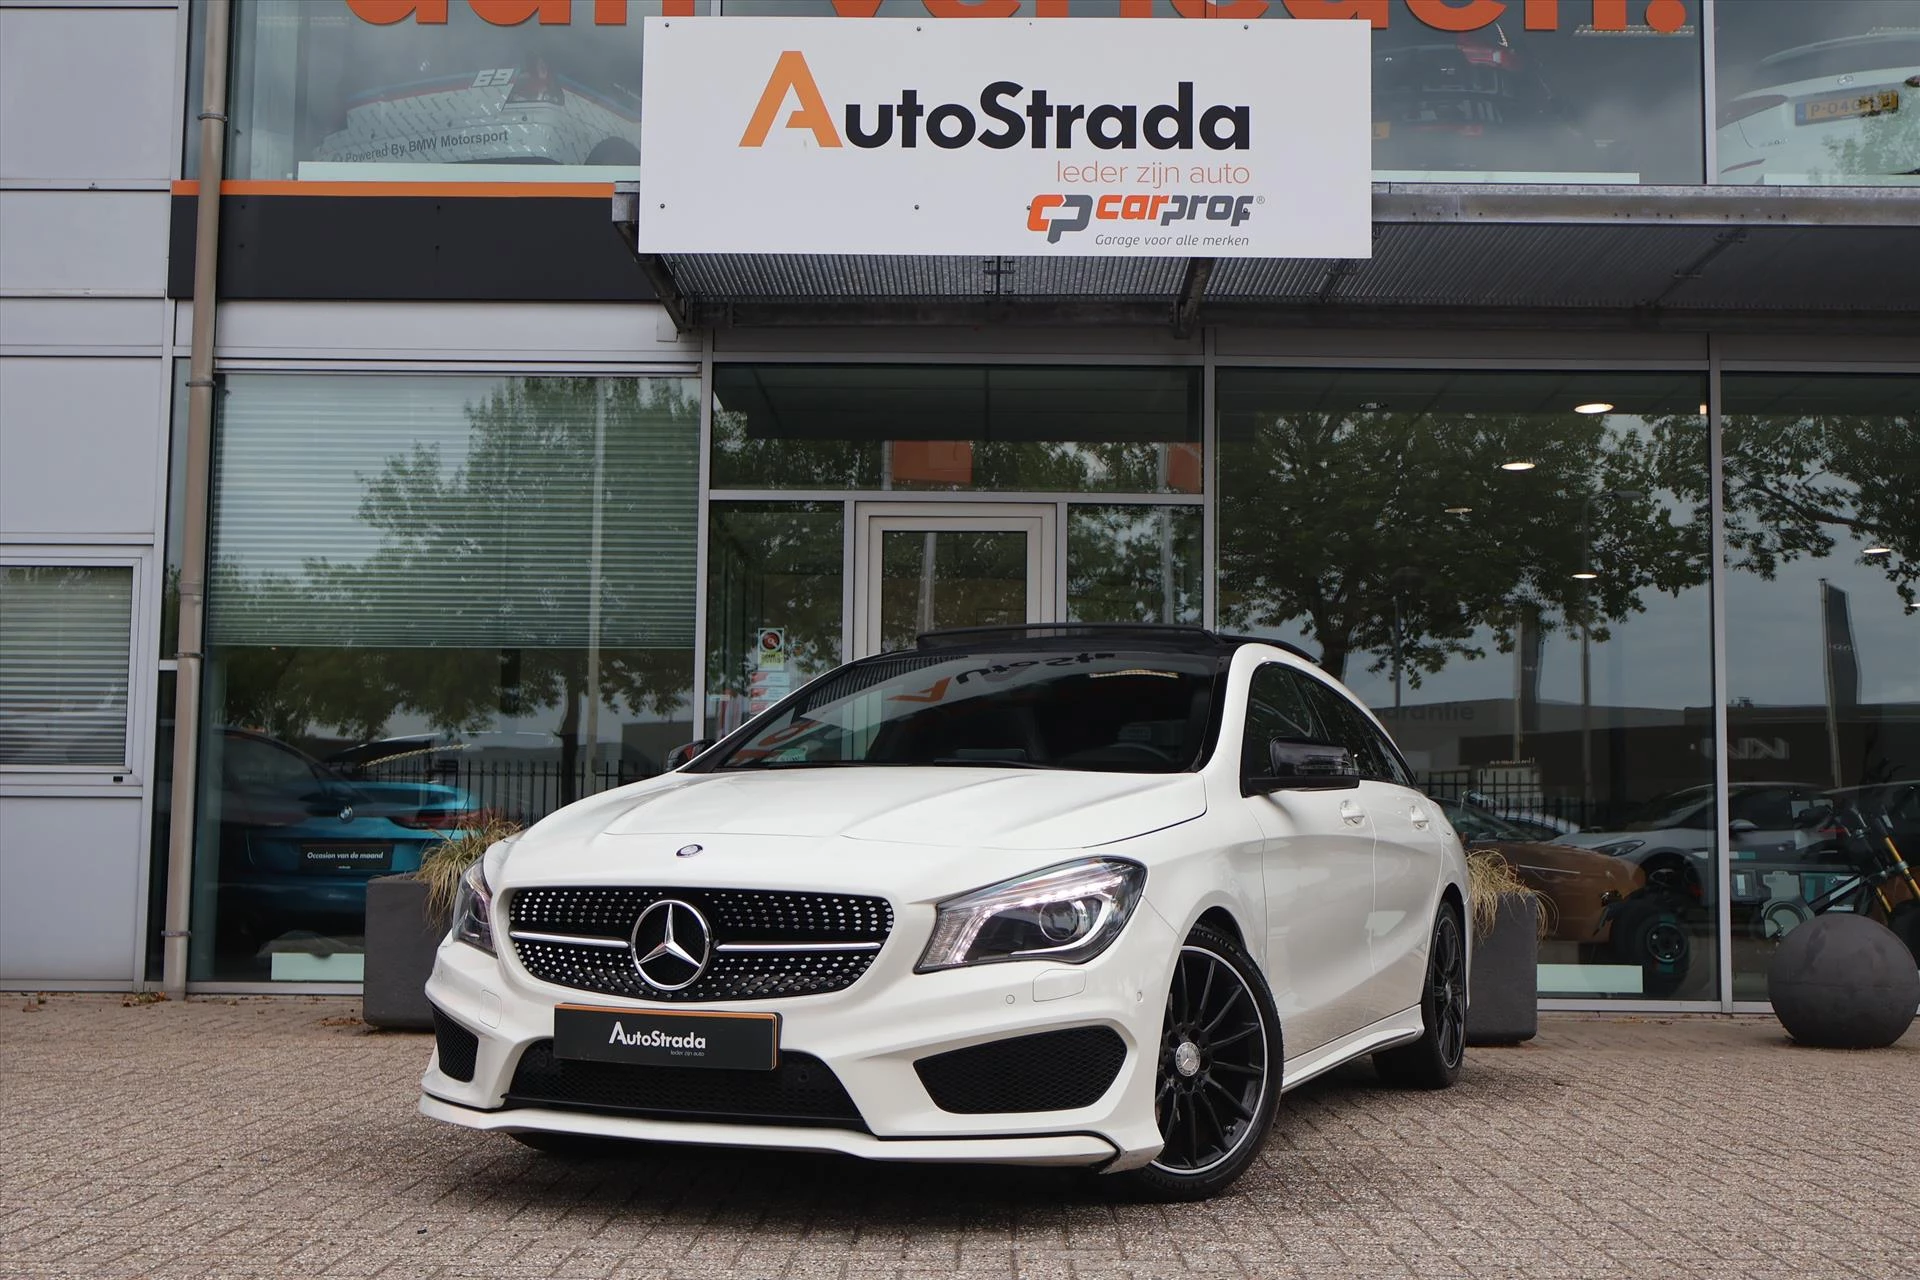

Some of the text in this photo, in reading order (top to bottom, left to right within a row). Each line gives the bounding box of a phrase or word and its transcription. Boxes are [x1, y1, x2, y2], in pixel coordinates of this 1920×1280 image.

[471, 68, 515, 88] 69
[738, 50, 1251, 150] AutoStrada
[344, 129, 509, 162] Powered By BMW Motorsport
[1056, 160, 1250, 189] Ieder zijn auto
[1095, 234, 1249, 248] Garage voor alle merken
[307, 851, 336, 859] Occasion
[350, 851, 359, 859] de
[608, 1021, 706, 1049] AutoStrada
